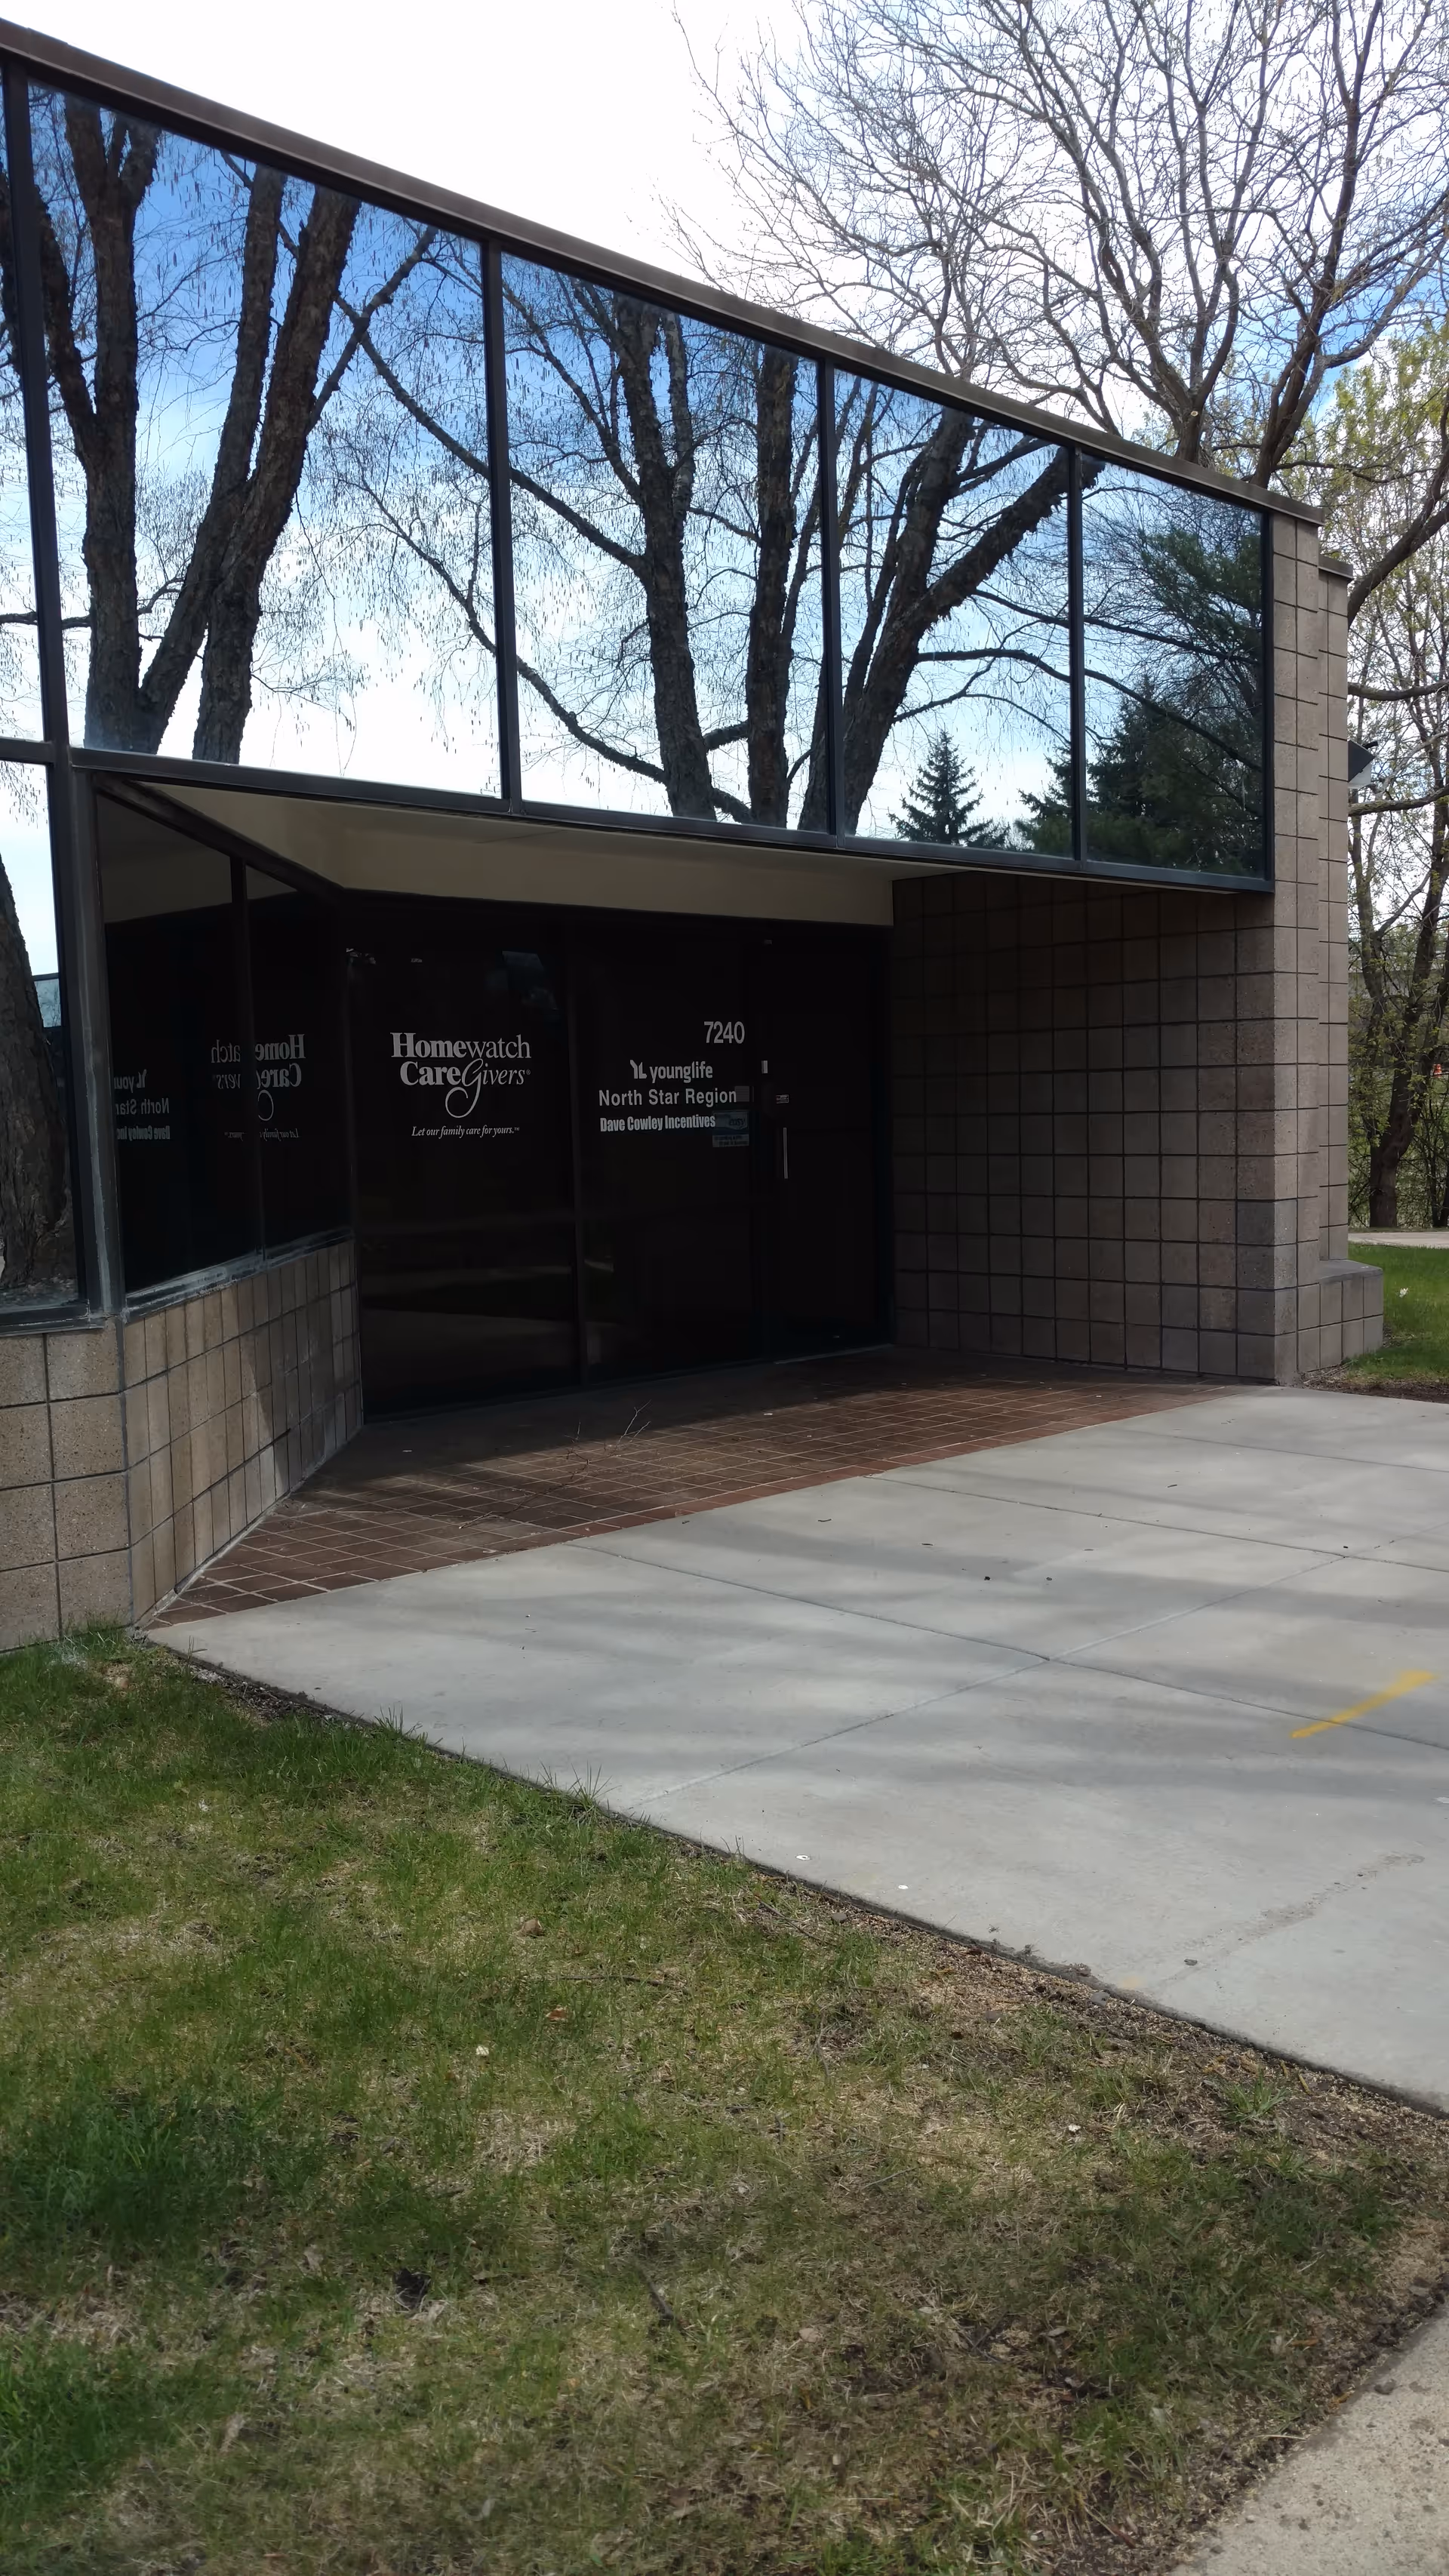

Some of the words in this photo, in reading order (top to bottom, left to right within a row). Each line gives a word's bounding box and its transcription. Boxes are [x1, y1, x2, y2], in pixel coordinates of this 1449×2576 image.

[703, 1020, 746, 1045] 7240
[389, 1032, 532, 1059] Homewatch
[649, 1060, 713, 1084] younglife
[598, 1089, 642, 1107] North
[648, 1088, 680, 1106] Star
[685, 1087, 737, 1108] Region
[411, 1125, 426, 1137] Let
[438, 1125, 465, 1140] family
[480, 1124, 493, 1138] for
[600, 1116, 625, 1132] Dave
[626, 1115, 664, 1131] Cowley
[664, 1113, 716, 1130] Incentives
